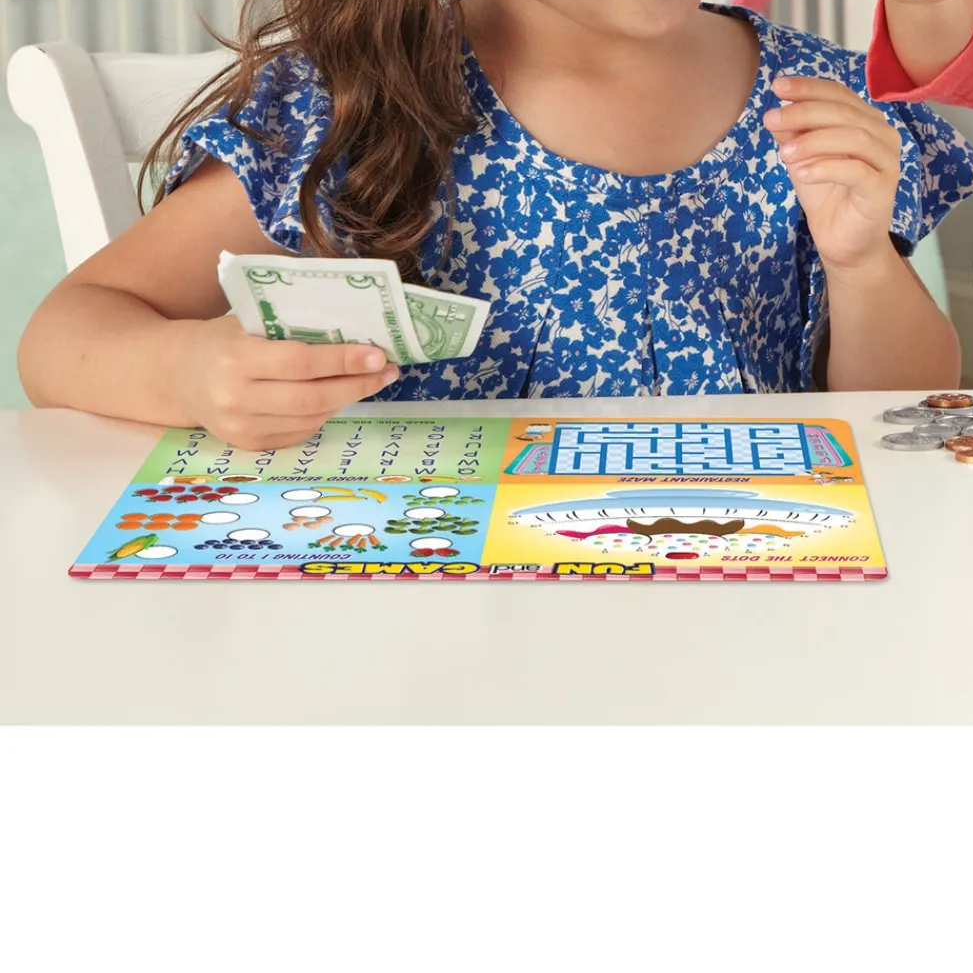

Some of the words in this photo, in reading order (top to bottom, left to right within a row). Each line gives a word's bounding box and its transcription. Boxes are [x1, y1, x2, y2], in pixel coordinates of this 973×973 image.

[247, 268, 293, 285] 5
[346, 274, 385, 289] 5
[232, 553, 259, 561] TO
[274, 553, 352, 561] COUNTING
[299, 562, 480, 575] GAMES
[488, 563, 543, 574] and
[550, 562, 655, 576] FUN
